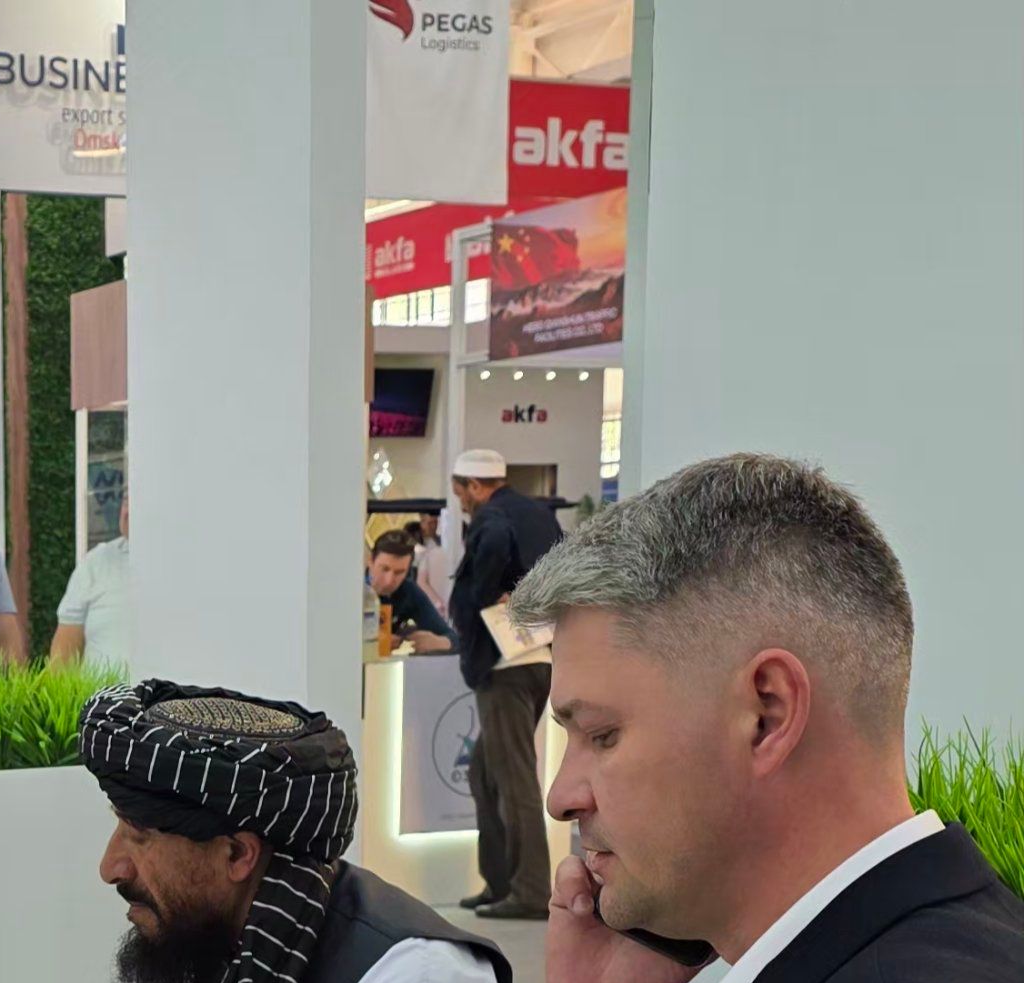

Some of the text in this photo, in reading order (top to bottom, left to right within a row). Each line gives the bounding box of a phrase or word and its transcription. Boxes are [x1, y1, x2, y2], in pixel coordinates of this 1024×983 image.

[421, 14, 493, 35] PEGAS
[421, 37, 481, 51] Logistics
[62, 107, 113, 127] export
[73, 128, 120, 150] Omsk
[513, 117, 629, 171] akfa
[374, 236, 416, 267] akfa
[501, 404, 548, 424] akfa
